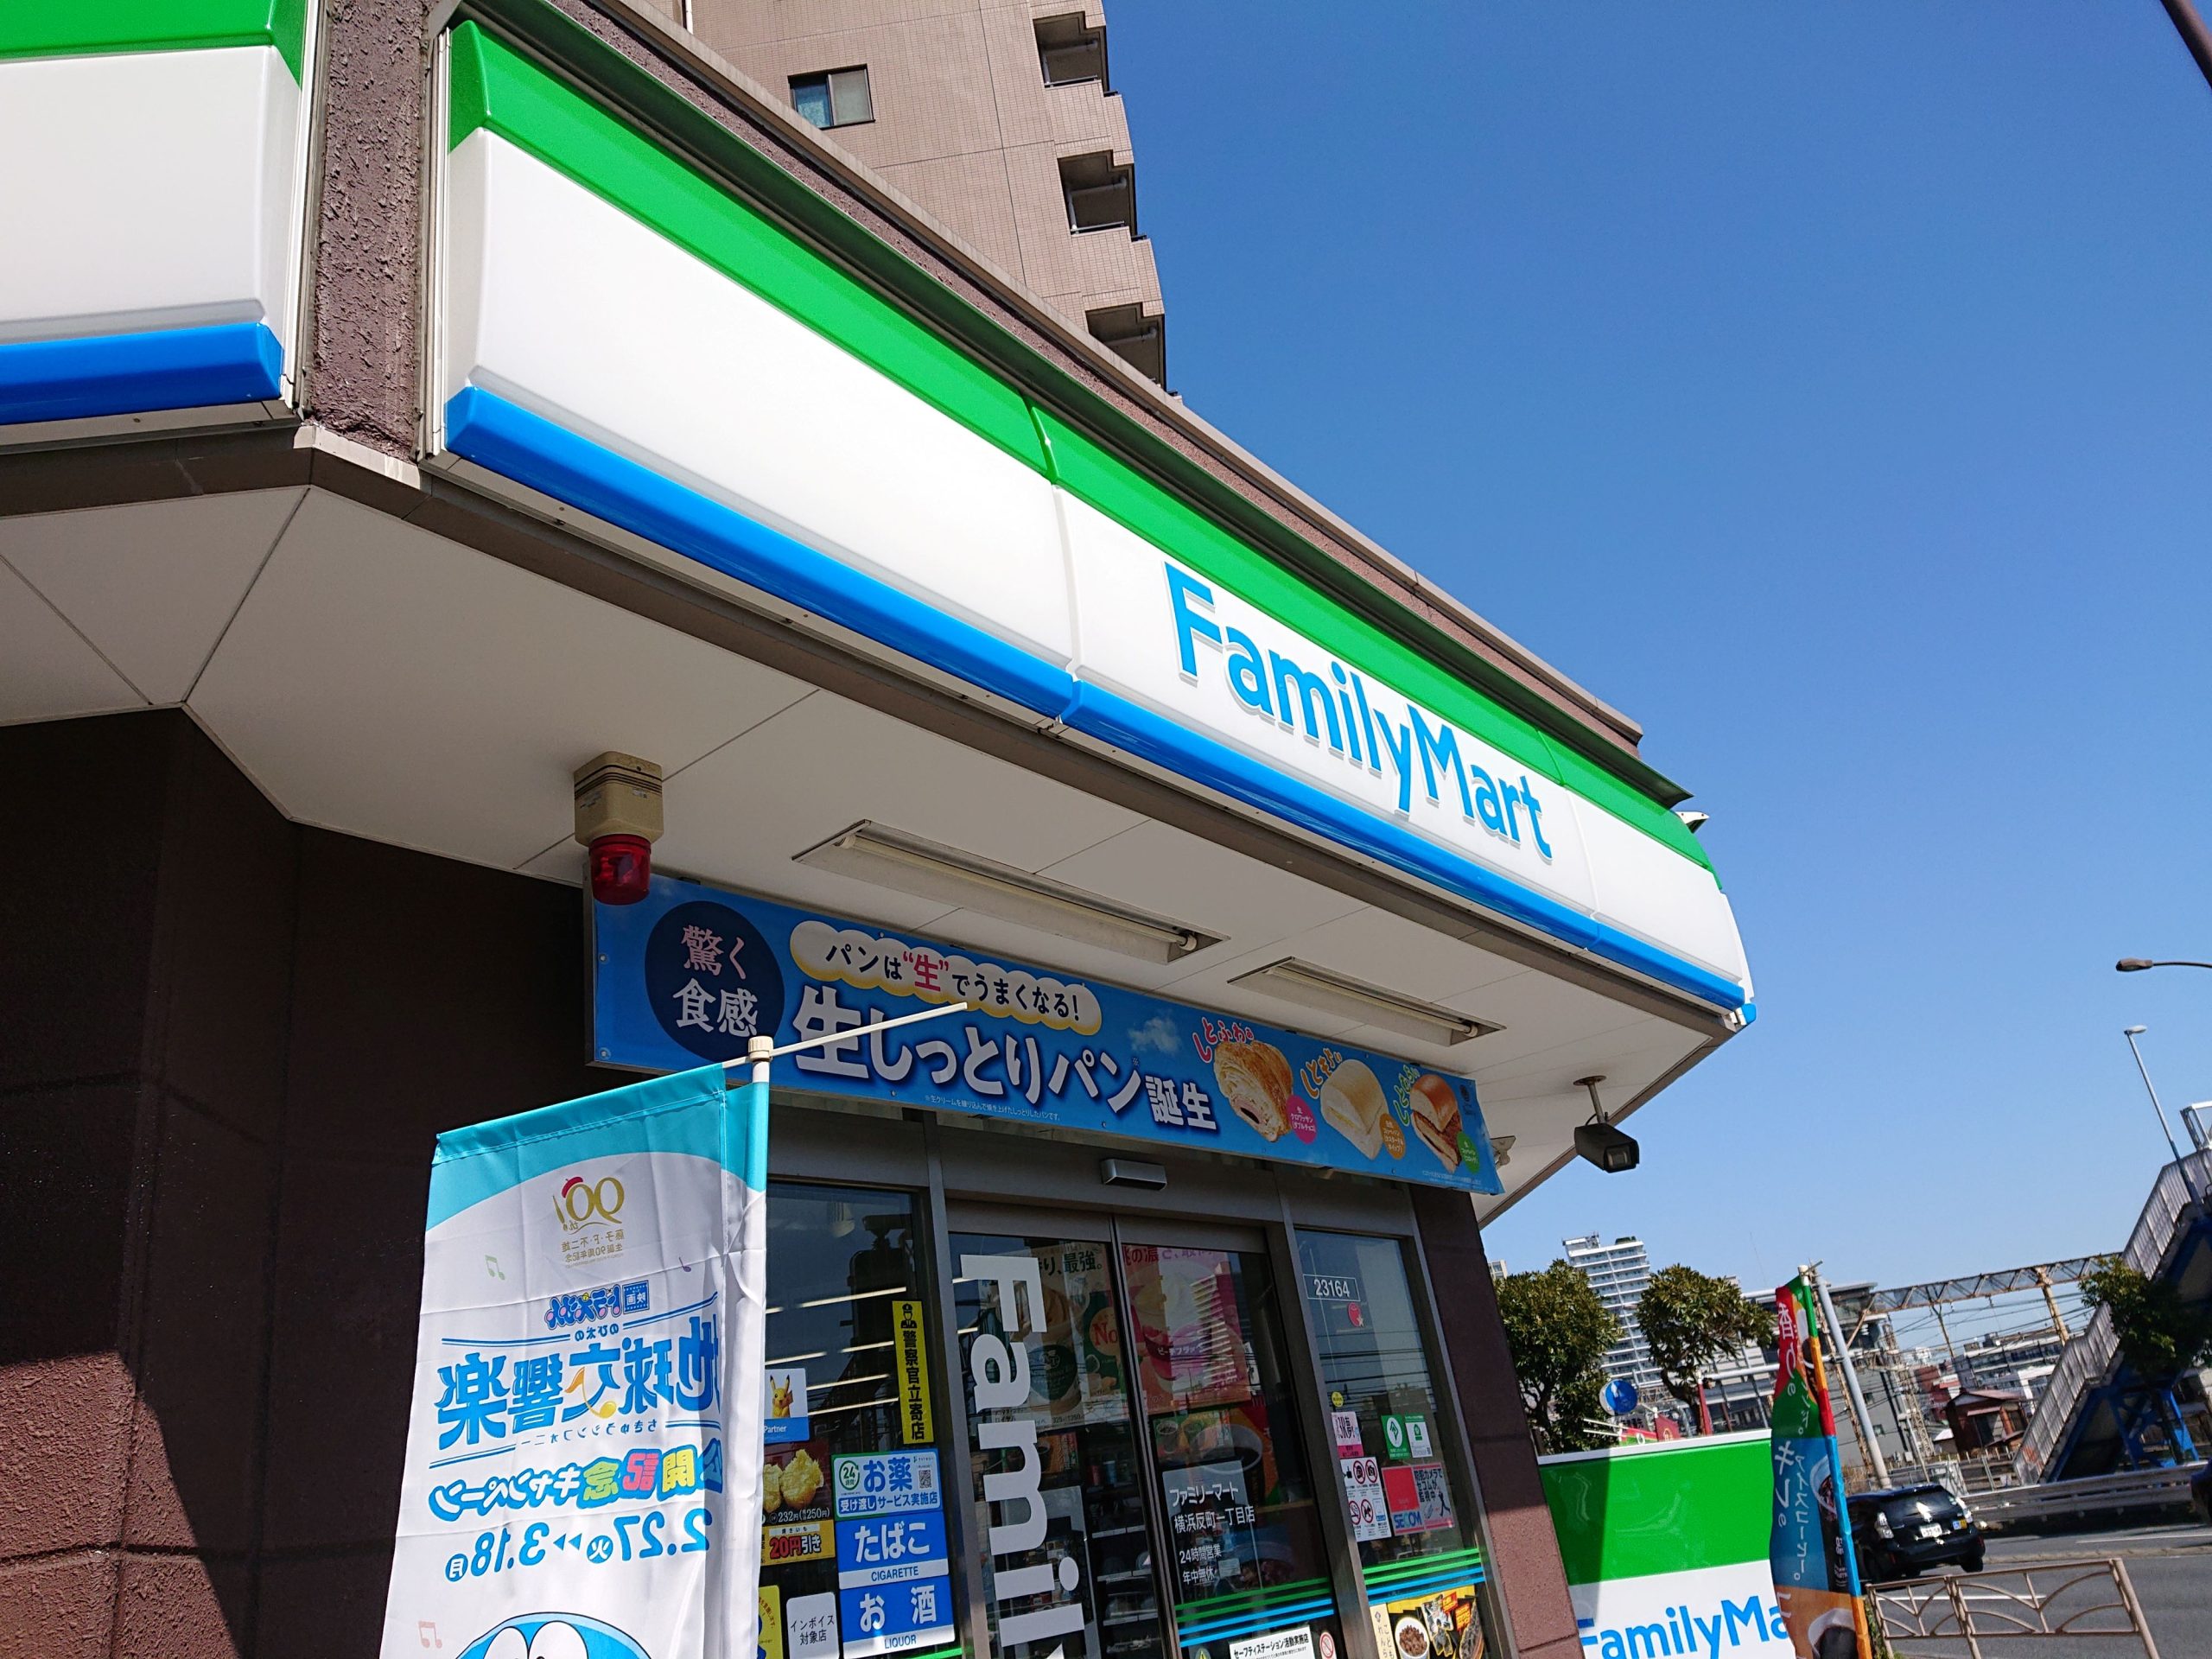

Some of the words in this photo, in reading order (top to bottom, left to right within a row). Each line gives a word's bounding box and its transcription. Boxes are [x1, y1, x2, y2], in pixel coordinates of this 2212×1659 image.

[1164, 562, 1553, 864] FamilyMart
[681, 925, 747, 980] 驚く
[673, 978, 758, 1037] 食感
[1313, 1278, 1351, 1298] 23164
[903, 1331, 925, 1440] 警察官立寄店
[763, 1425, 787, 1433] Partner
[962, 1254, 1085, 1659] Famil
[843, 1466, 855, 1479] 24
[863, 1457, 912, 1492] お薬
[1169, 1481, 1239, 1508] ファミリーマート
[1173, 1505, 1255, 1534] 横浜反町一丁目店
[1394, 1511, 1422, 1529] SECOM
[769, 1534, 822, 1559] 20円引き
[855, 1522, 930, 1563] たばこ
[1179, 1544, 1223, 1564] 24時間営業
[871, 1566, 919, 1582] CIGARETTE
[1182, 1565, 1216, 1585] 年中無休
[790, 1614, 835, 1633] インボイス
[799, 1630, 827, 1645] 対象店
[885, 1634, 917, 1649] LIQUOR
